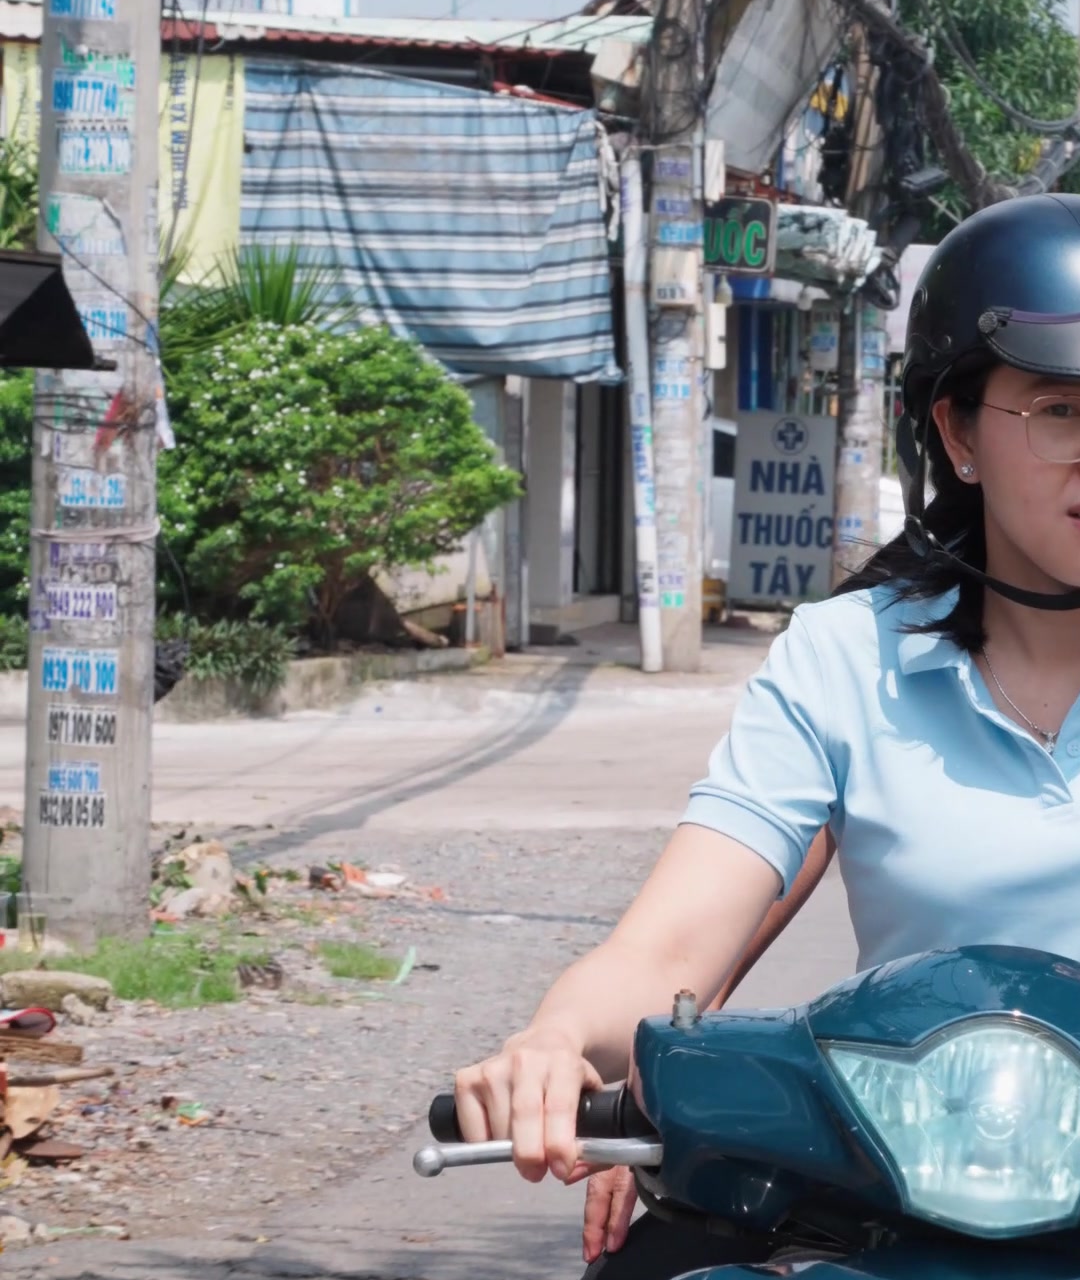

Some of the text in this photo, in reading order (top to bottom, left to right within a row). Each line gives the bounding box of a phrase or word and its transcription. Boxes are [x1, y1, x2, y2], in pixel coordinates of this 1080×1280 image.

[704, 202, 766, 266] UỐC
[750, 455, 825, 496] NHÀ
[738, 503, 834, 549] THUỐC
[750, 556, 815, 597] TÂY
[73, 591, 91, 618] 222
